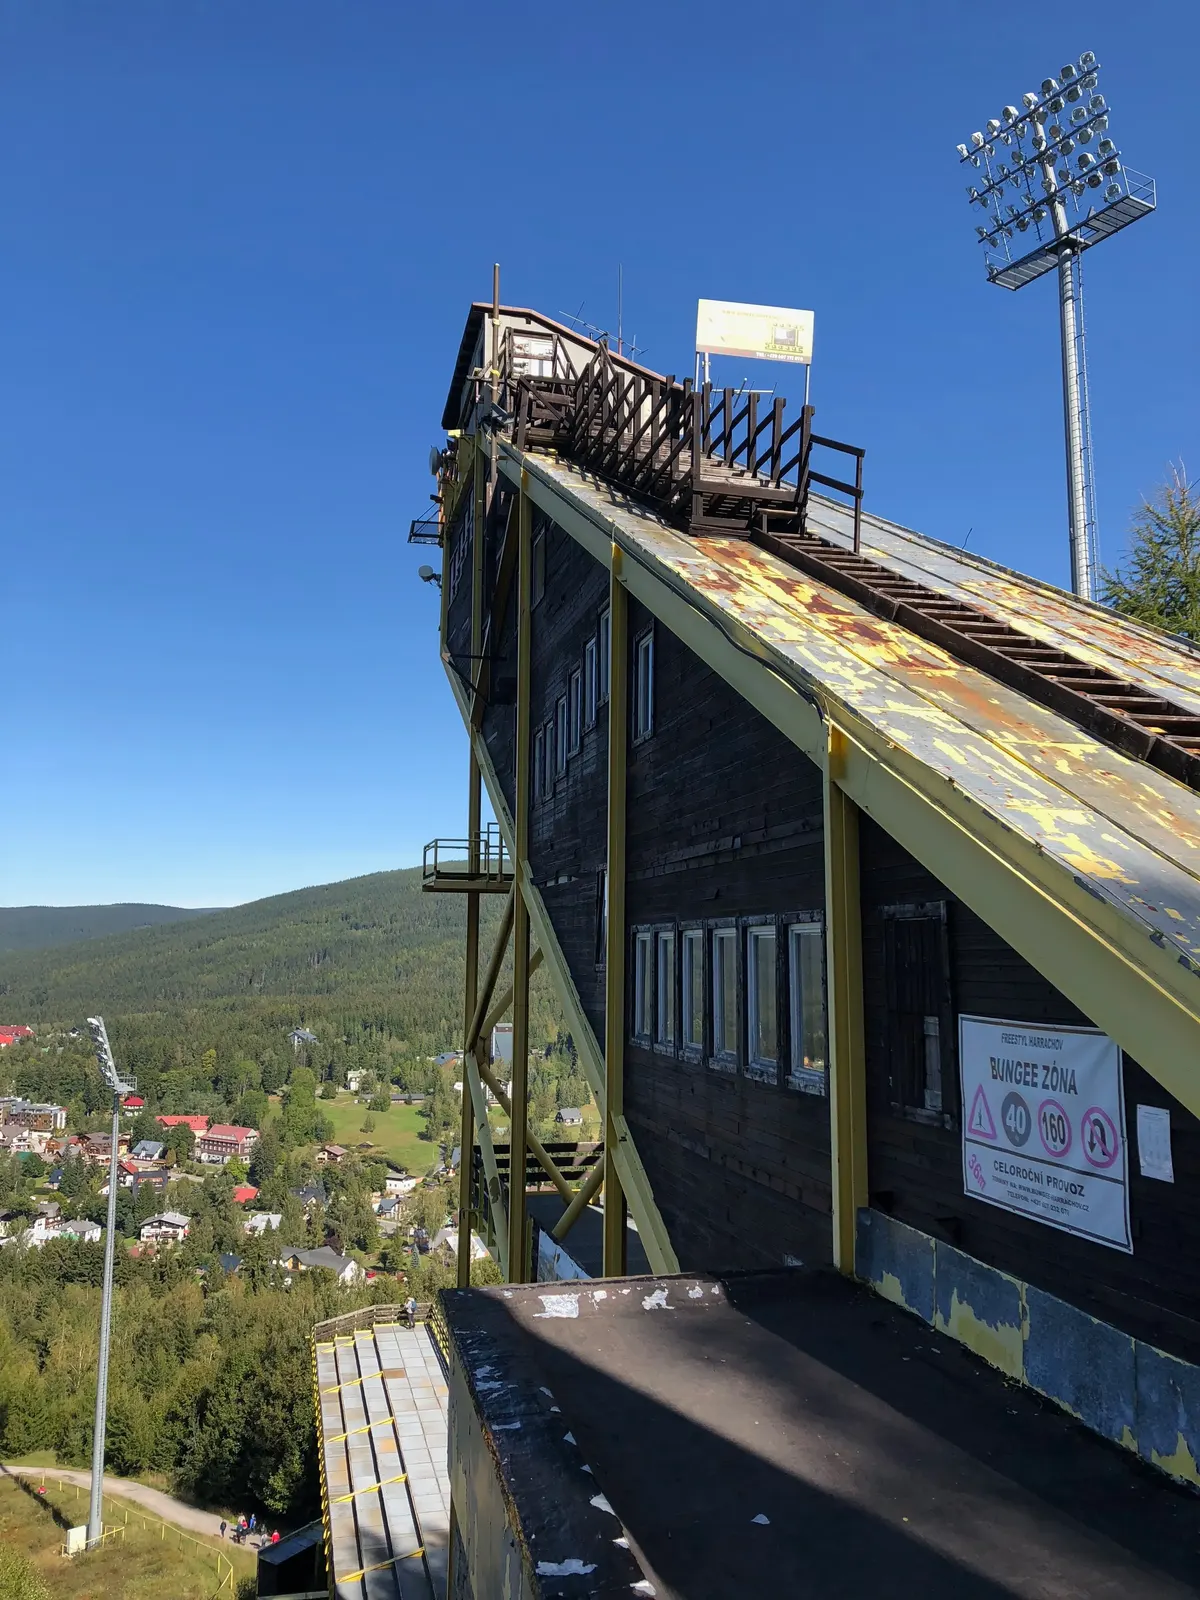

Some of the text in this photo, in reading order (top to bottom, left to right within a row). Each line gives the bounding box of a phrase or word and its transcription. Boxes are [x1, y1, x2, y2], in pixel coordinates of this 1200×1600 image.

[1001, 1032, 1064, 1050] FREESTYL HARRACHOV
[989, 1056, 1078, 1095] BUNGEE ZÓNA
[1006, 1104, 1026, 1135] 40
[1042, 1112, 1066, 1145] 160
[968, 1153, 986, 1190] 36m
[993, 1160, 1044, 1185] CELOROČNÍ
[1046, 1175, 1085, 1198] PROVOZ
